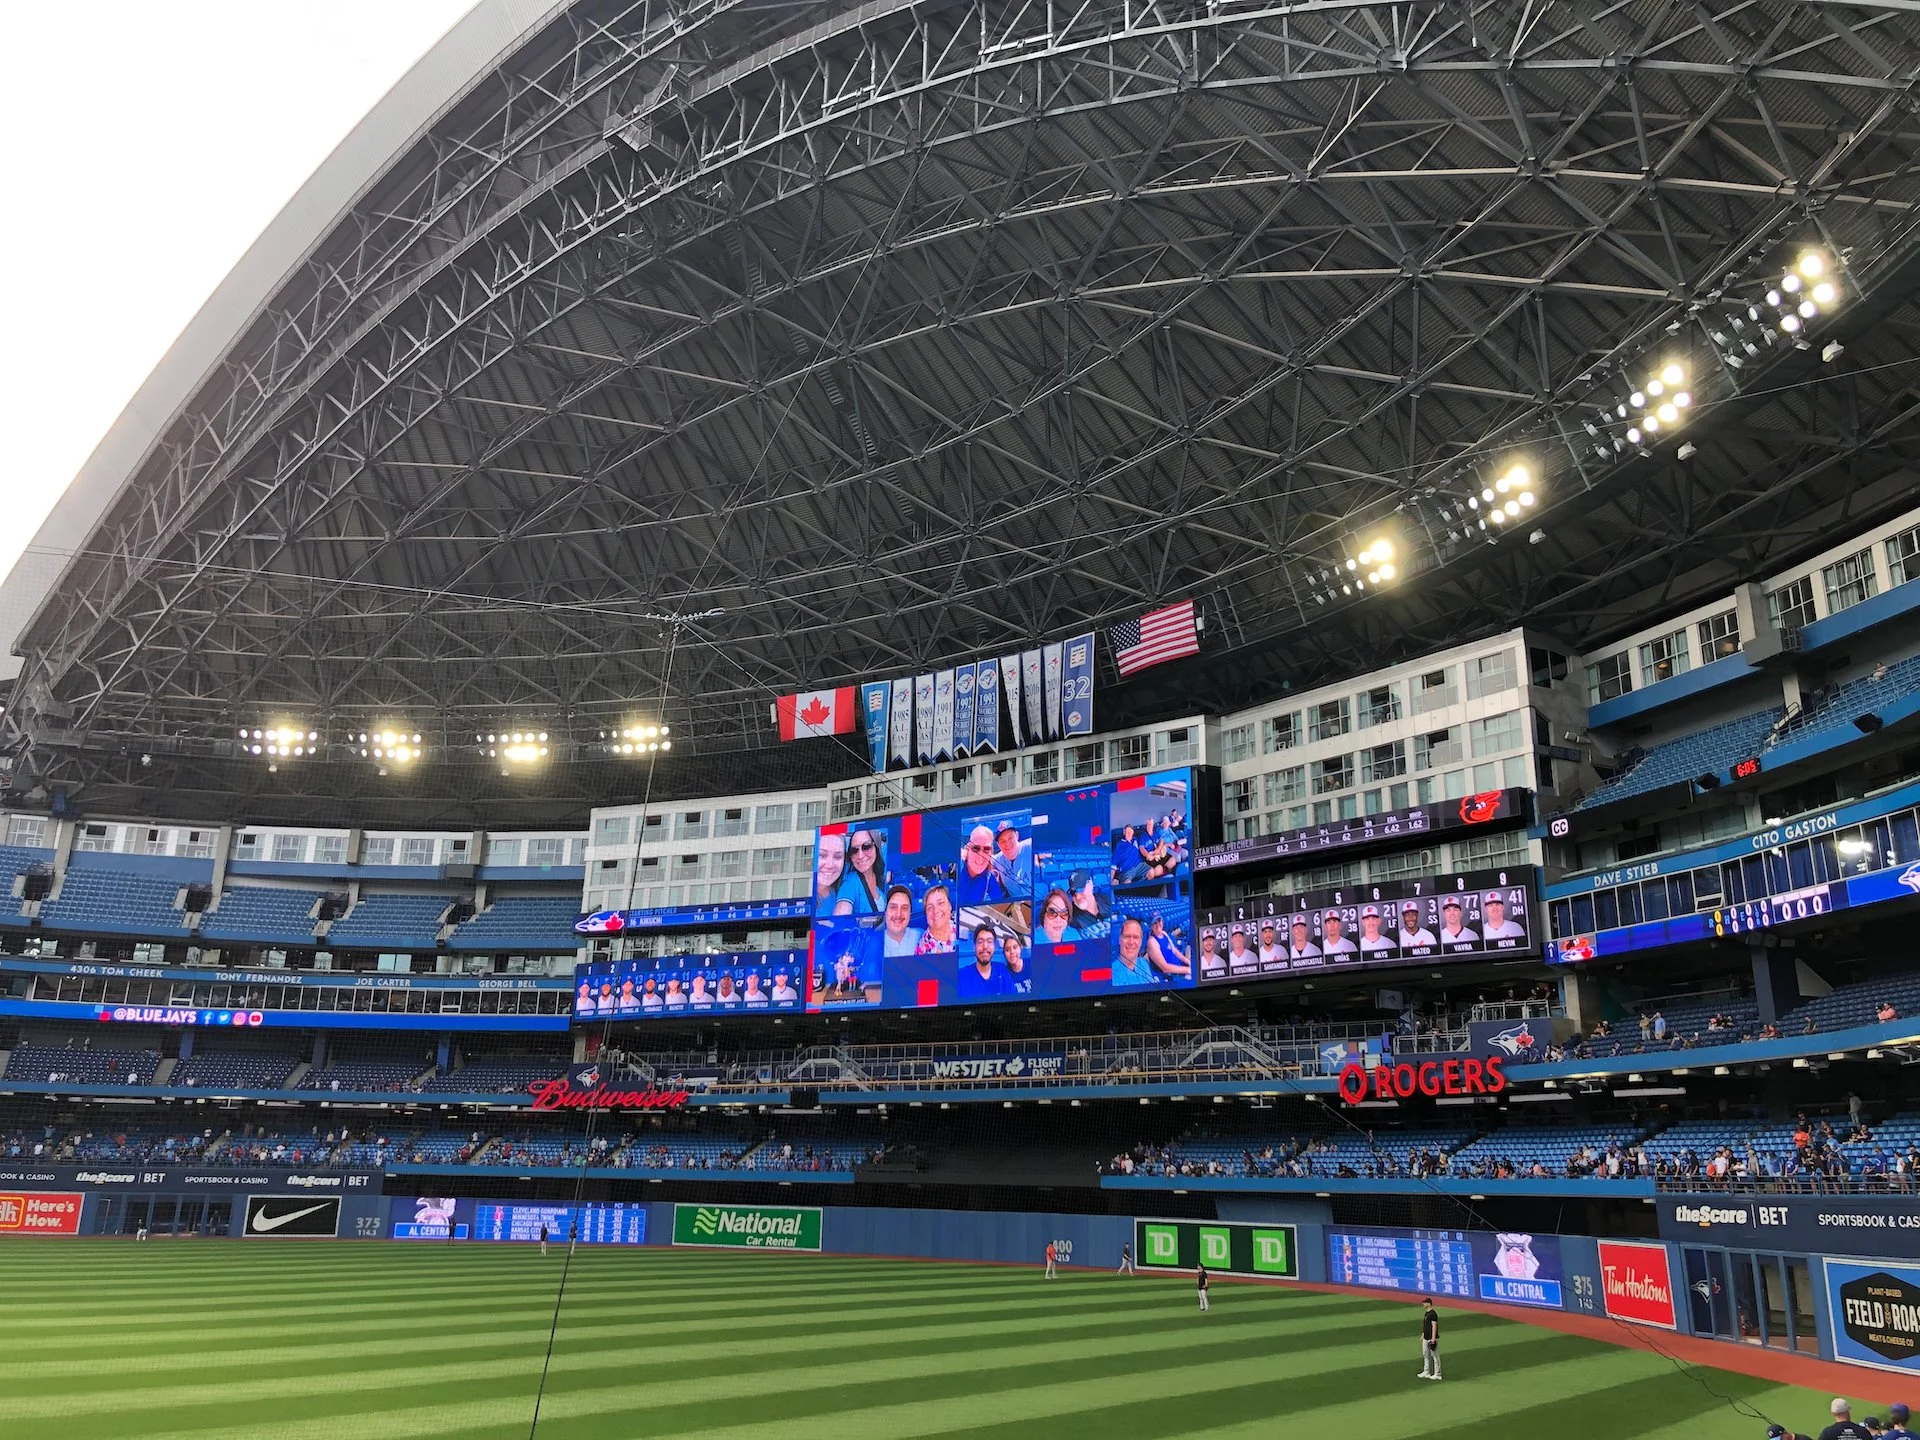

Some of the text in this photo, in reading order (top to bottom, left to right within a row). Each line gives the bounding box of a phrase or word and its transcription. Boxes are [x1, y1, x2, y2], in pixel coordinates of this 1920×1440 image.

[1063, 676, 1090, 702] 32
[980, 692, 996, 707] 1993
[893, 709, 909, 721] 1985
[1737, 760, 1757, 777] 6:05
[1553, 821, 1568, 834] CC
[1752, 812, 1837, 850] CITO GASTON
[1194, 839, 1254, 857] STARTING PITCHER
[1197, 858, 1207, 868] 56
[1210, 852, 1240, 866] BRADISH
[1300, 840, 1307, 849] 13
[1342, 832, 1351, 841] 62
[1365, 829, 1374, 837] 23
[1384, 824, 1399, 834] 6.42
[1408, 820, 1423, 830] 1.62
[1593, 861, 1659, 888] DAVE STIEB
[1208, 872, 1507, 924] 1 2 3 4 5 6 7 8 9
[1463, 894, 1478, 909] 77
[1508, 890, 1523, 904] 41
[1383, 903, 1396, 918] 21
[1428, 899, 1436, 913] 3
[1512, 906, 1524, 916] DH
[1782, 896, 1822, 920] 0 0 0
[1313, 913, 1320, 925] 6
[1342, 908, 1356, 922] 29
[1428, 915, 1438, 924] SS
[1469, 911, 1480, 920] 2B
[1708, 900, 1767, 928] R 0 H 0 E 0 0
[629, 918, 637, 926] 16
[639, 916, 663, 926] KIKUCHI
[1275, 918, 1288, 931] 25
[1388, 919, 1398, 929] LF
[1716, 913, 1769, 936] 0 0 0 0
[1215, 927, 1228, 939] 26
[1245, 922, 1257, 935] 35
[1454, 943, 1473, 952] VAVRA
[1498, 939, 1516, 948] NEVIN
[1374, 951, 1389, 959] HAYS
[1412, 947, 1431, 956] MATEO
[588, 953, 794, 975] 1 2 3 4 5 6 7 8 9
[70, 965, 164, 978] 4306 TOM CHEEK
[682, 971, 690, 981] 11
[705, 970, 717, 979] 26
[735, 968, 744, 979] 15
[793, 966, 800, 976] 9
[215, 972, 303, 985] TONY FERNANDEZ
[355, 977, 411, 987] JOE CARTER
[478, 979, 537, 989] GEORGE BELL
[635, 974, 643, 984] 13
[657, 973, 666, 983] 37
[114, 1008, 197, 1024] @BLUEJAYS
[933, 1057, 1062, 1079] WESTJET FLIGHT
[1374, 1056, 1506, 1098] ROGERS
[529, 1080, 689, 1109] Budweiser
[76, 1172, 135, 1184] theScore
[144, 1172, 166, 1183] BET
[184, 1176, 233, 1184] SPORTSBOOK
[287, 1175, 341, 1187] theScore
[349, 1176, 369, 1186] BET
[26, 1199, 74, 1213] Here's
[24, 1214, 62, 1227] How.
[356, 1217, 380, 1229] 375
[718, 1211, 802, 1235] National
[1675, 1205, 1747, 1226] theScore
[1758, 1206, 1789, 1226] BET
[1818, 1214, 1887, 1228] SPORTSBOOK
[1888, 1216, 1896, 1228] &
[409, 1226, 419, 1236] AL
[746, 1236, 796, 1247] Car Rental
[1149, 1232, 1283, 1264] TD TD TD
[1495, 1280, 1546, 1300] NL CENTRAL
[1573, 1275, 1593, 1296] 375
[1604, 1265, 1668, 1304] Tim Hortons
[1846, 1298, 1884, 1328] FIELD
